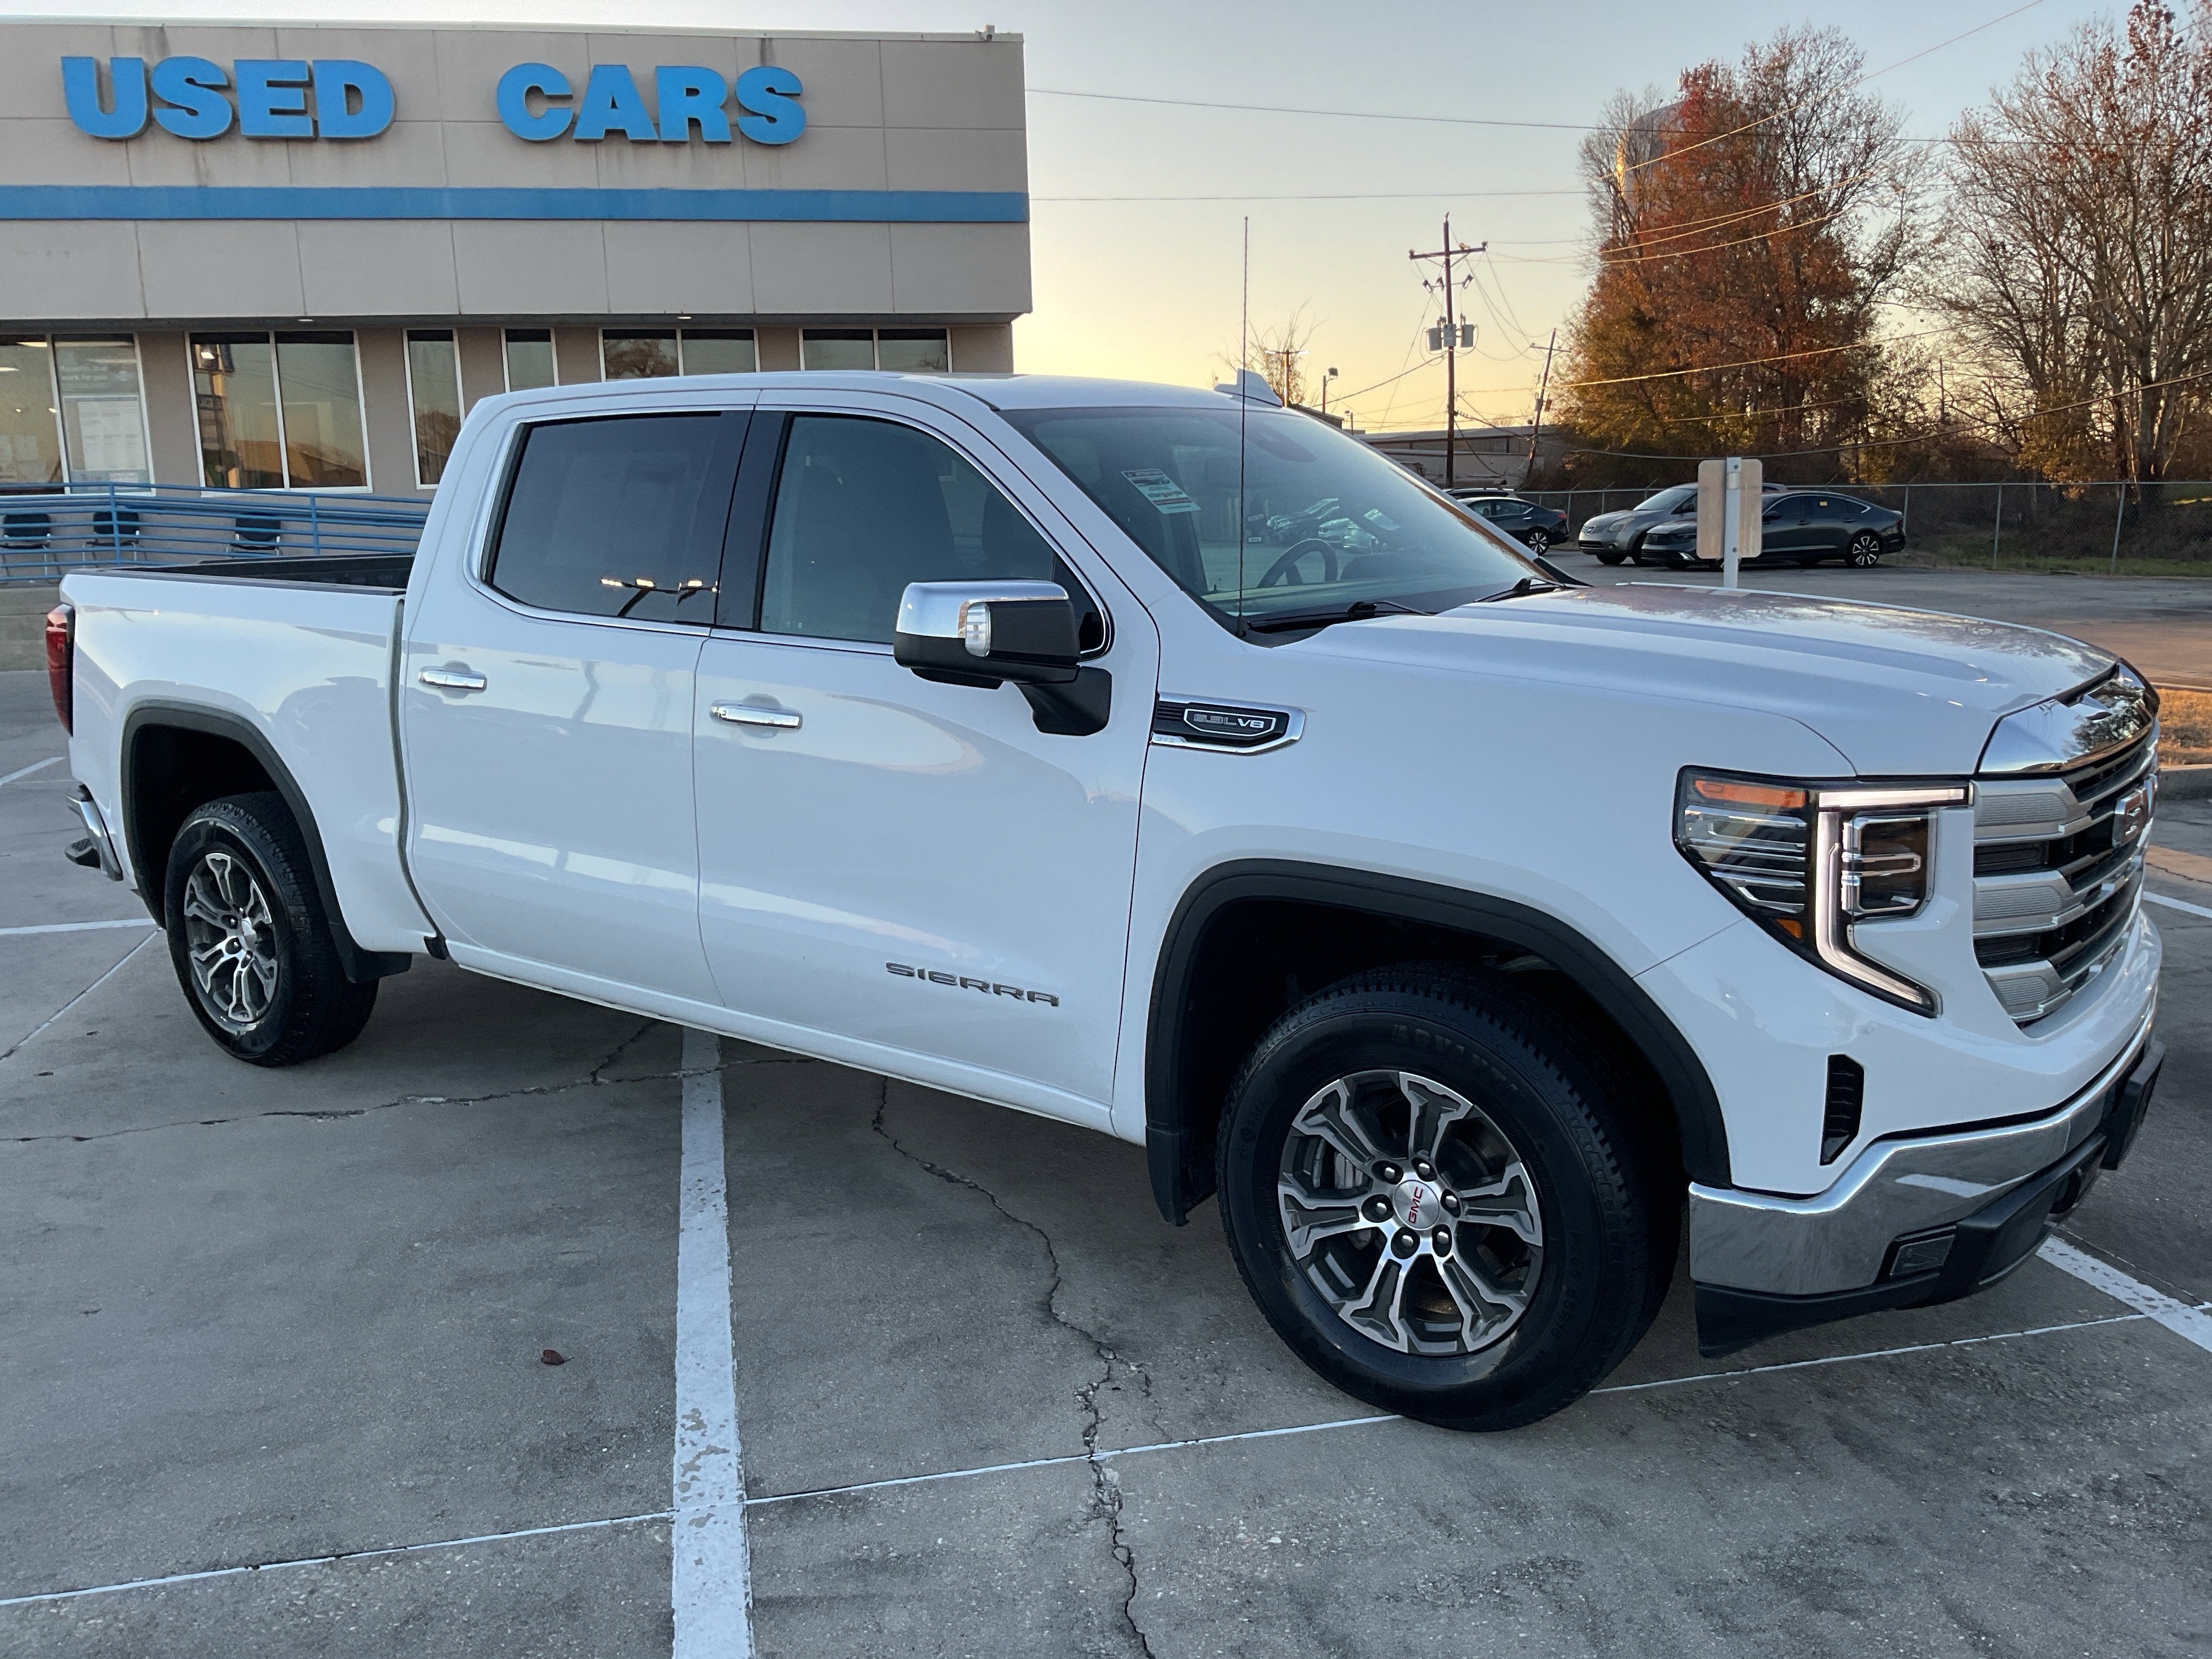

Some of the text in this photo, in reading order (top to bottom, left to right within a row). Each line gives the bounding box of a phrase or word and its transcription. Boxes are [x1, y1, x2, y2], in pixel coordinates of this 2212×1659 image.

[60, 55, 807, 145] USED CARS
[885, 961, 1059, 1007] SIERRA
[1408, 1186, 1424, 1224] GMC
